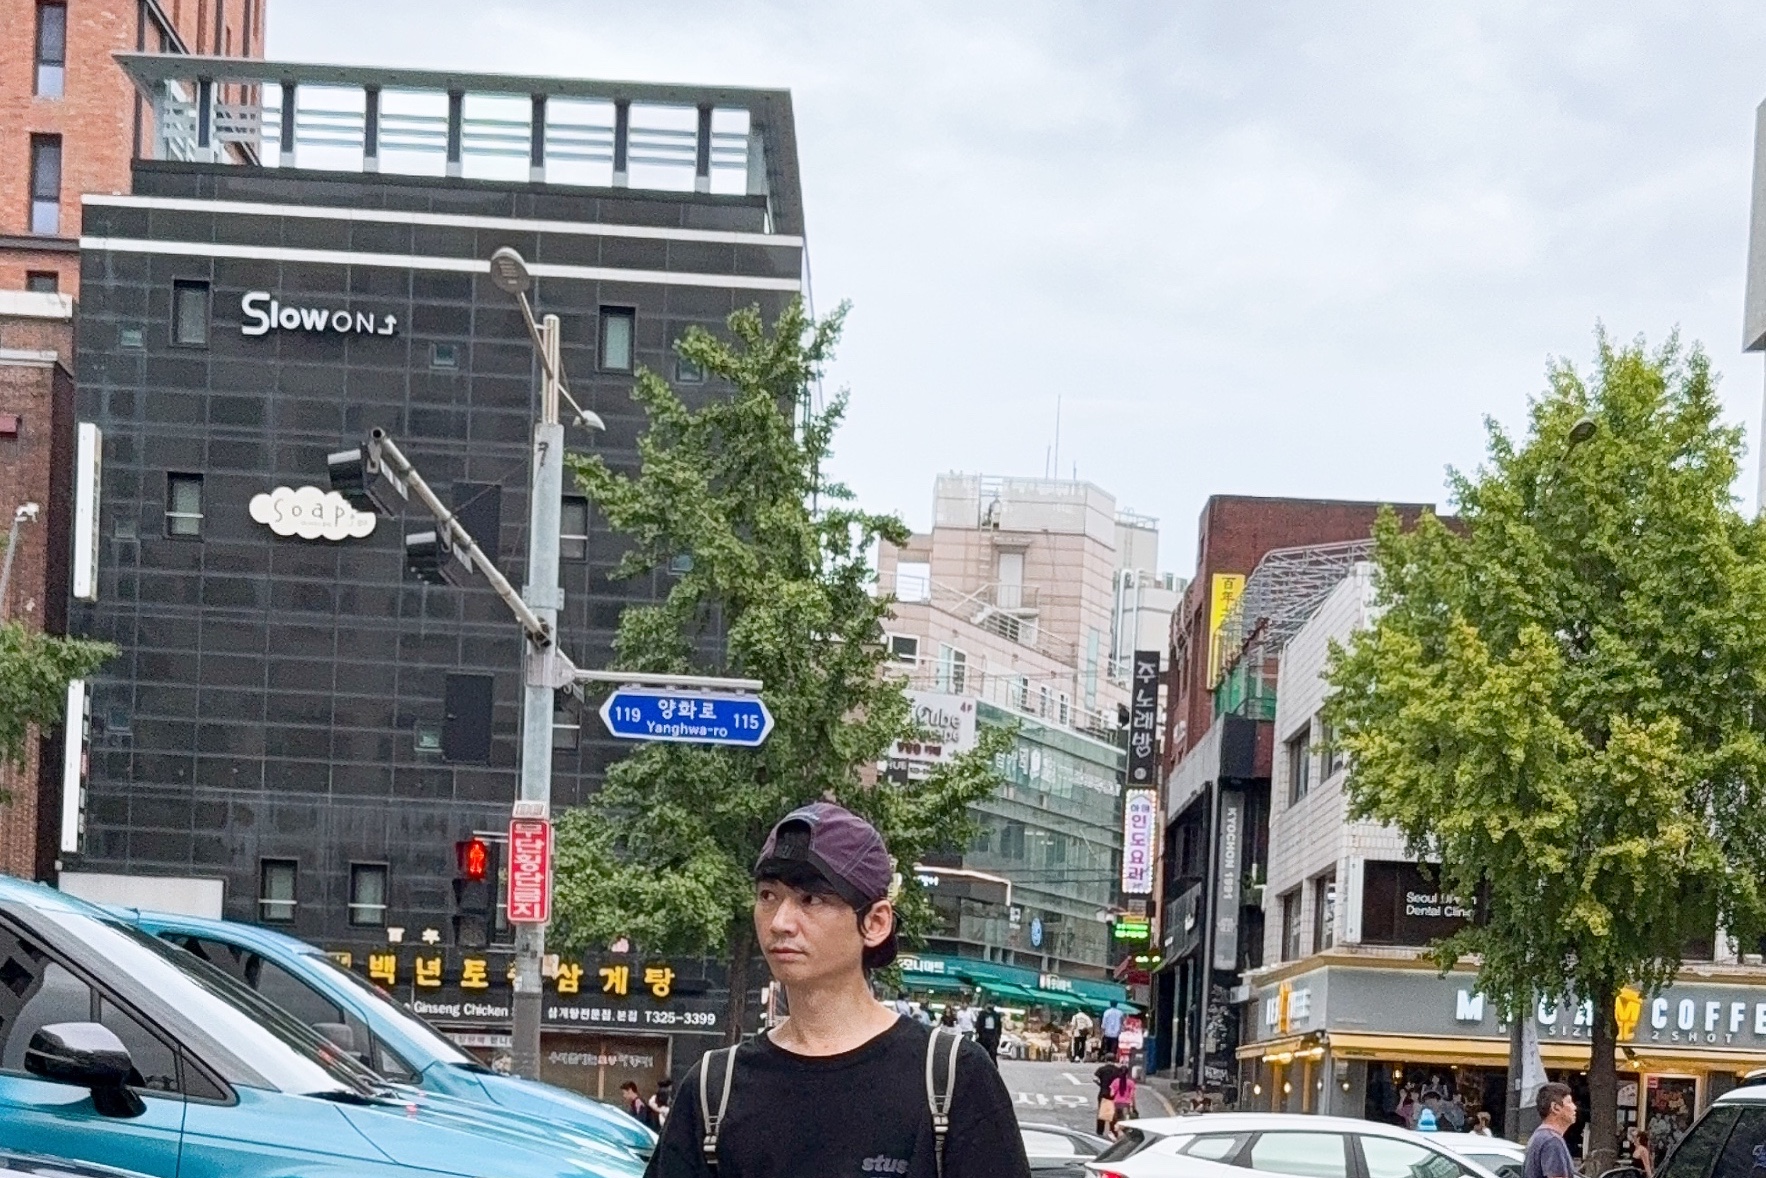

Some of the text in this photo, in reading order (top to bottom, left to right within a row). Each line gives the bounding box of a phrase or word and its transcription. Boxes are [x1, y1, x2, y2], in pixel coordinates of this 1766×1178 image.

[615, 699, 760, 730] 119 양화로 115
[646, 720, 728, 738] Yanghwa-ro
[1224, 807, 1237, 869] KYOCHON
[1406, 891, 1437, 904] Seoul
[1406, 904, 1442, 917] Dental
[414, 1001, 460, 1017] Ginseng
[463, 1003, 509, 1017] Chicken
